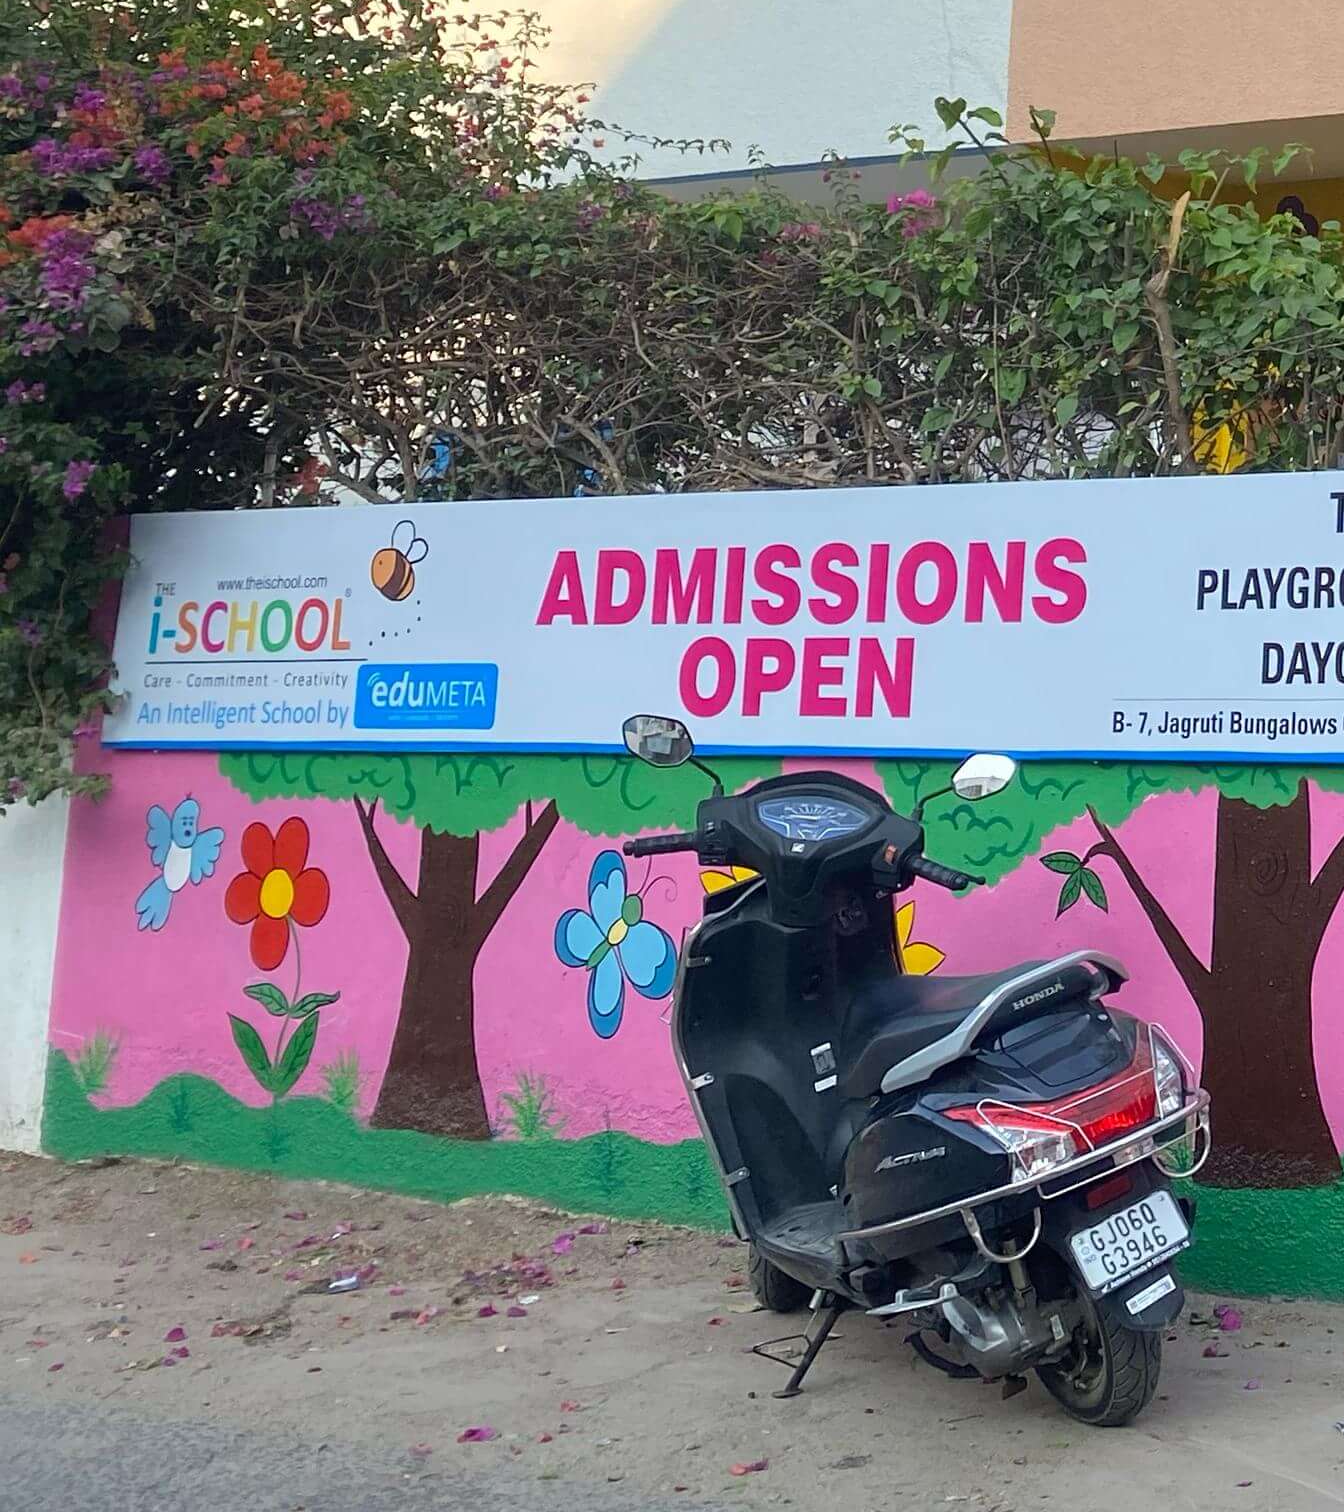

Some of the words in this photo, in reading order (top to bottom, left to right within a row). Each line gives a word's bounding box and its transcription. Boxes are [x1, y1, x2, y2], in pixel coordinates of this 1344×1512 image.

[156, 582, 177, 596] THE
[535, 537, 1089, 625] ADMISSIONS
[148, 596, 352, 655] i-SCHOOL
[143, 673, 172, 689] Care
[186, 672, 268, 688] Commitment
[283, 671, 349, 689] Creativity
[371, 670, 487, 707] eduMETA
[678, 635, 916, 719] OPEN
[137, 701, 161, 725] An
[167, 700, 256, 730] Intelligent
[260, 699, 322, 725] School
[326, 699, 350, 729] by
[1112, 711, 1133, 734] B-
[1138, 712, 1152, 737] 7,
[1157, 711, 1224, 739] Jagruti
[1229, 711, 1338, 741] Bungalows
[1012, 982, 1065, 1012] HONDA
[1090, 1202, 1157, 1252] GJ06Q
[1101, 1225, 1168, 1275] G3946
